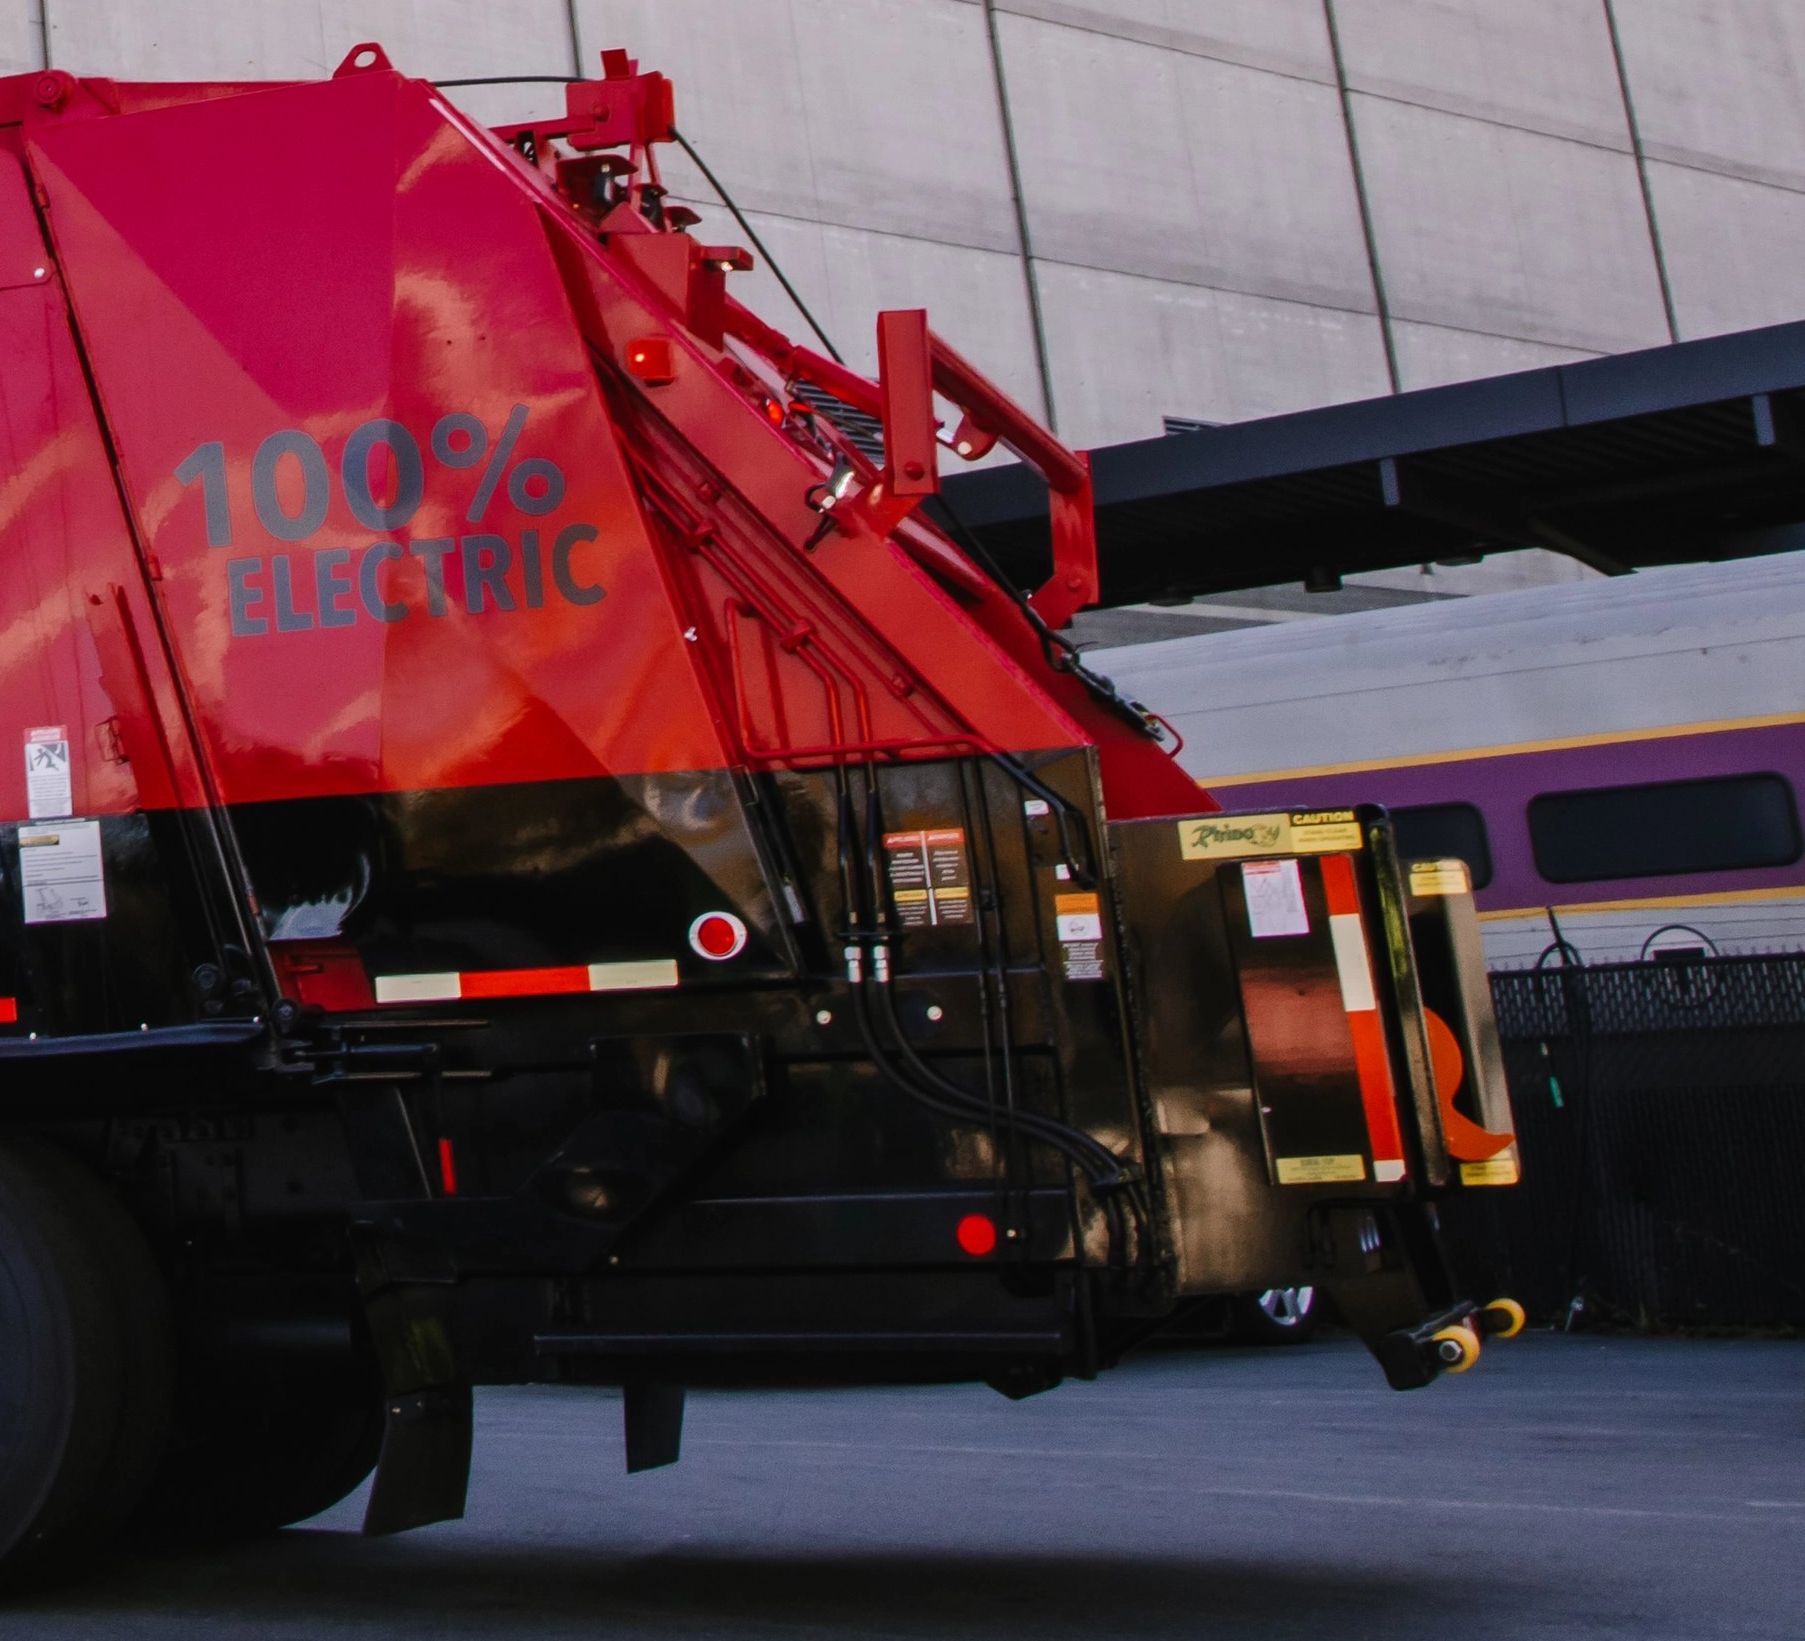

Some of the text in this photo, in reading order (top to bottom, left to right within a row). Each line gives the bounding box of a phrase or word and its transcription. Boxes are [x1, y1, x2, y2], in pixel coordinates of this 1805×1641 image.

[173, 403, 566, 548] 100%
[226, 523, 608, 637] ELECTRIC
[1292, 810, 1354, 825] CAUTION
